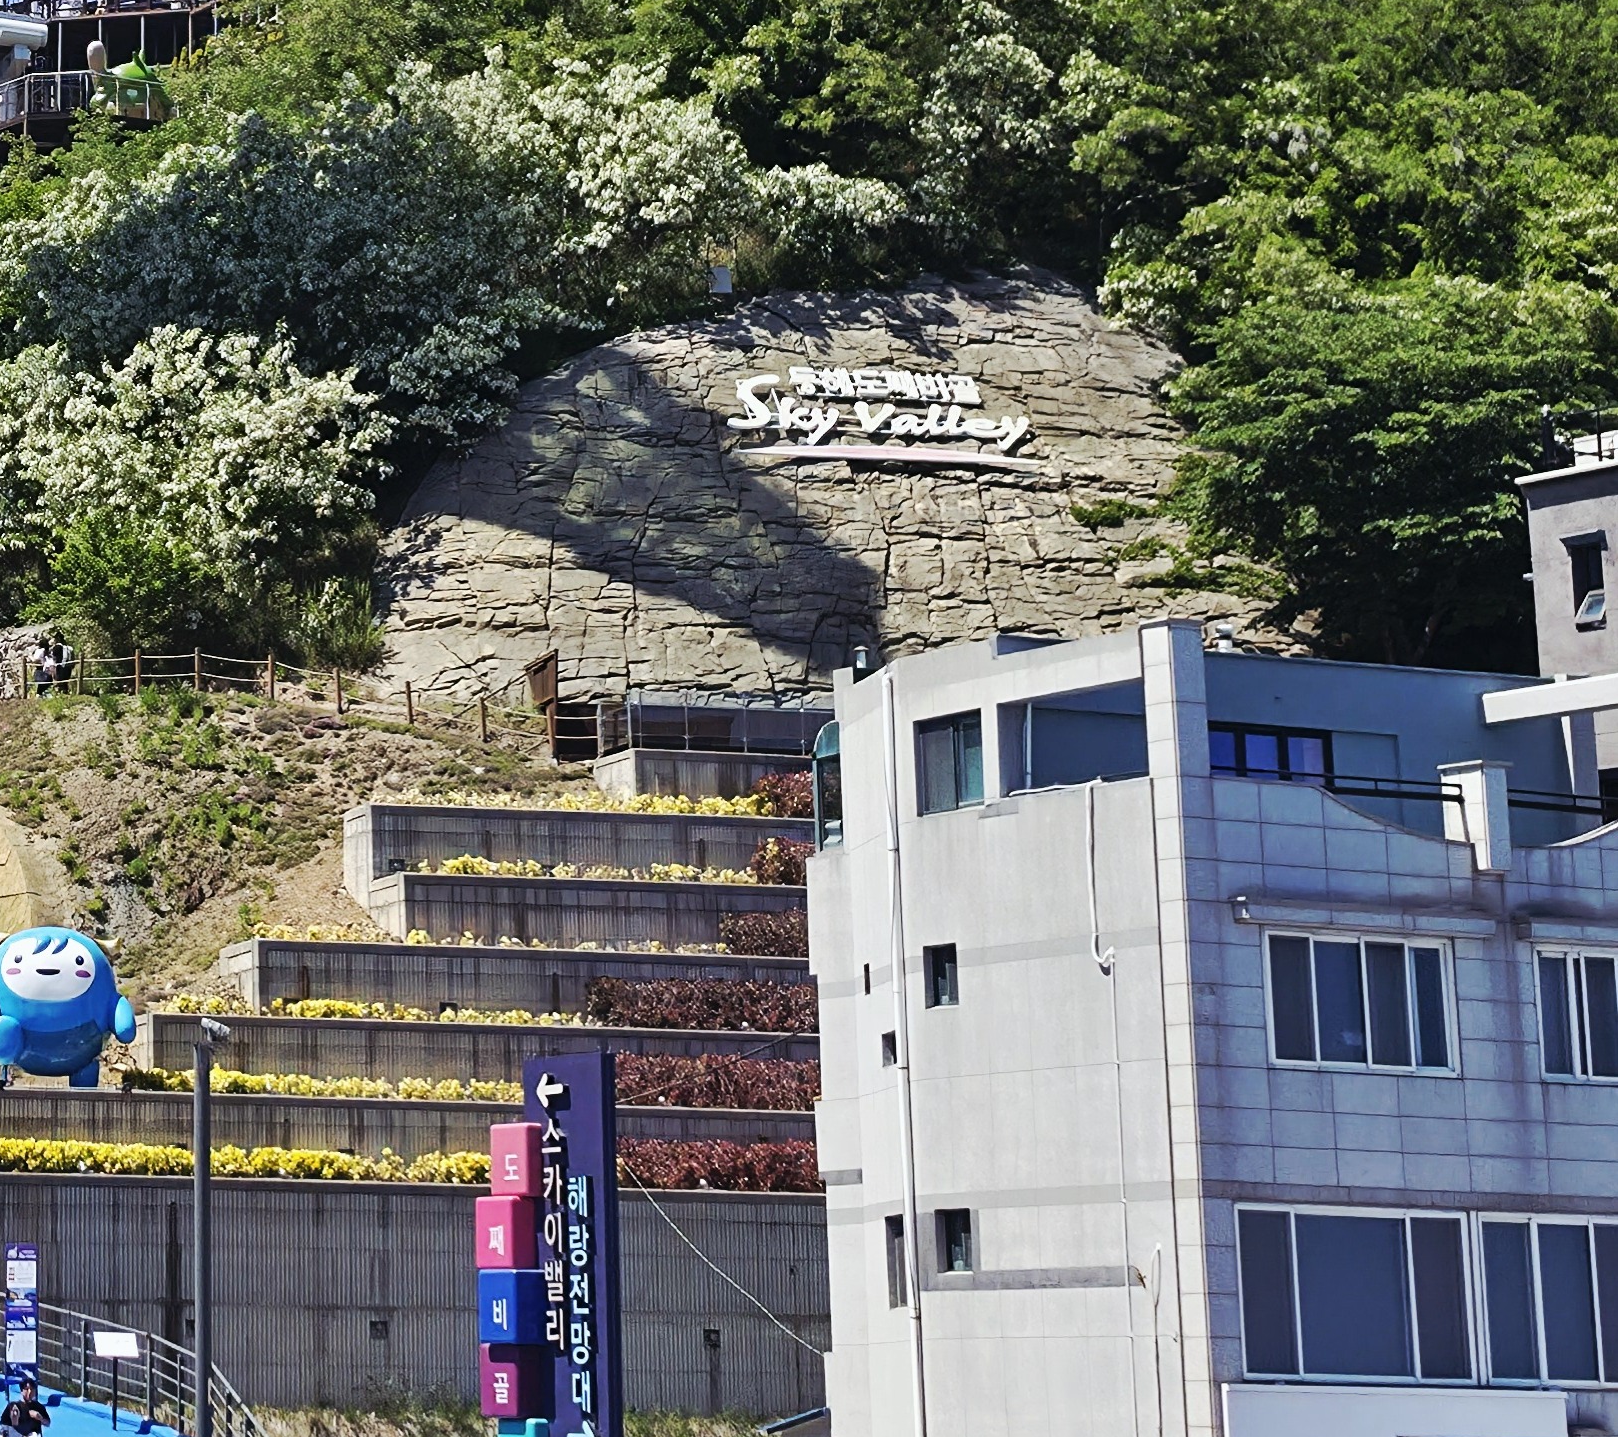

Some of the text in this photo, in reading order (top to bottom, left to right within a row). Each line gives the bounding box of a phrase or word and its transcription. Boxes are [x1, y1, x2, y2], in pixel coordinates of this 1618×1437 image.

[727, 374, 1030, 451] Sky Valley
[541, 1118, 564, 1351] 스카이밸리
[567, 1174, 591, 1414] 해랑전망대
